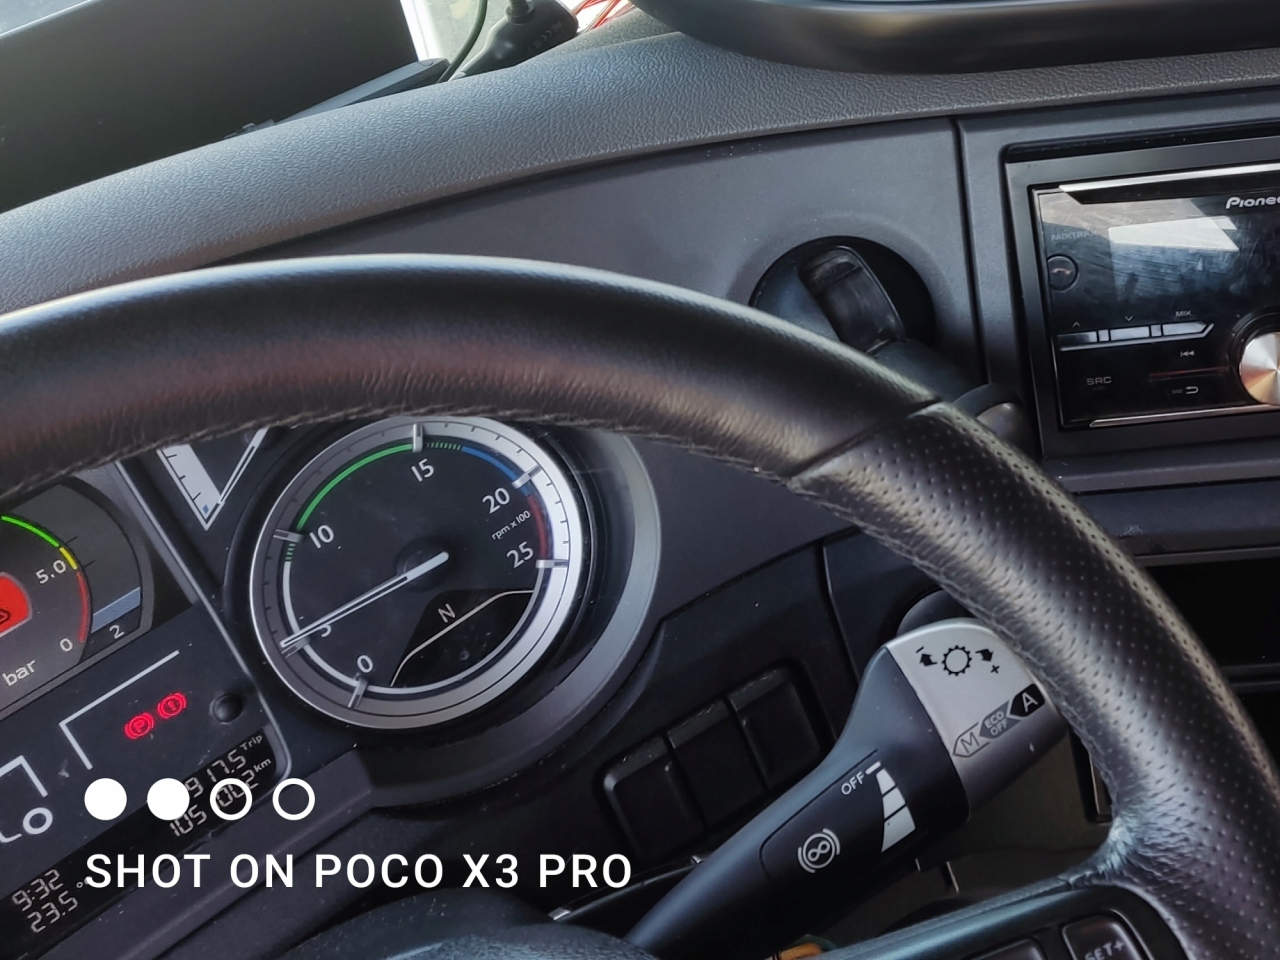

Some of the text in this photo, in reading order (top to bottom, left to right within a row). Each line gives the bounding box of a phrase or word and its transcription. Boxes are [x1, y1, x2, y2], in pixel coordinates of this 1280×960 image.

[1175, 309, 1192, 318] MIX
[411, 458, 435, 482] 15
[482, 487, 511, 514] 20
[491, 510, 531, 540] rpm x 100
[309, 524, 335, 549] 10
[506, 541, 534, 568] 25
[35, 559, 67, 584] 5.0
[438, 603, 456, 623] N
[109, 624, 125, 639] 2
[59, 638, 73, 652] 0
[3, 659, 37, 687] bar
[357, 655, 374, 673] 0
[1022, 693, 1038, 712] A
[984, 711, 1005, 729] ECO
[990, 720, 1008, 736] OFF
[240, 735, 263, 752] Trip
[960, 732, 980, 754] M
[253, 758, 272, 773] km
[841, 771, 865, 795] OFF
[12, 869, 63, 911] 9:32
[27, 891, 78, 933] 23.5
